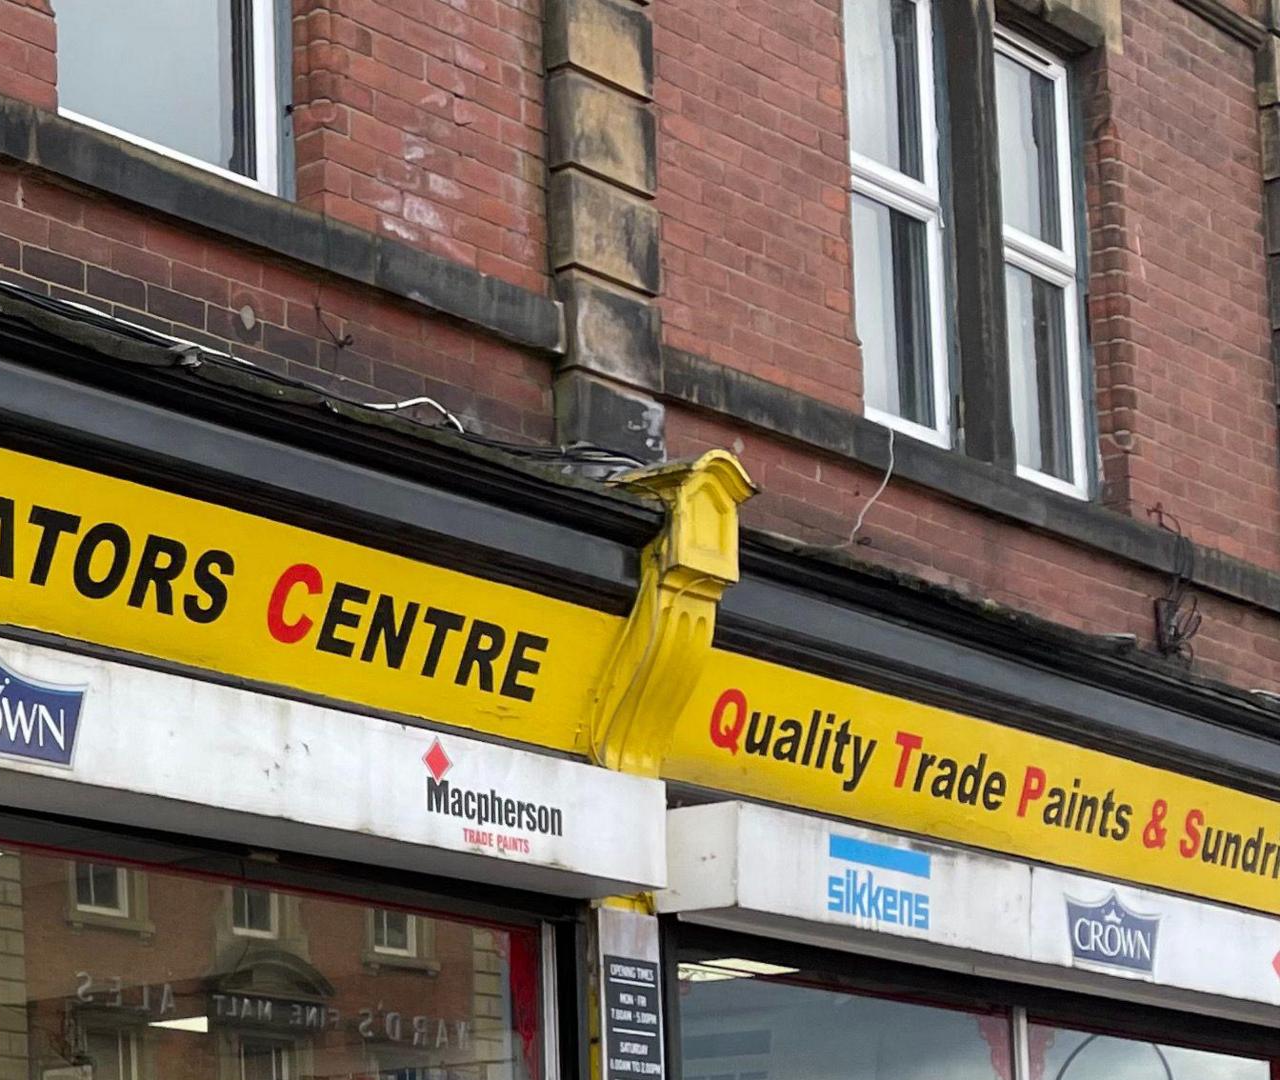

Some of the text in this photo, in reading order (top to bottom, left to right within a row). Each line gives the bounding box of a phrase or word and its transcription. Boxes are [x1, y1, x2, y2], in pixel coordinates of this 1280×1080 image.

[266, 561, 550, 701] CENTRE
[709, 688, 877, 793] Quality
[893, 731, 1007, 811] Trade
[1016, 766, 1134, 842] Paints
[1141, 799, 1168, 850] &
[426, 777, 563, 836] Macpherson
[463, 827, 530, 854] TRADE PAINTS
[827, 869, 931, 930] sikkens
[1074, 917, 1152, 961] CROWN
